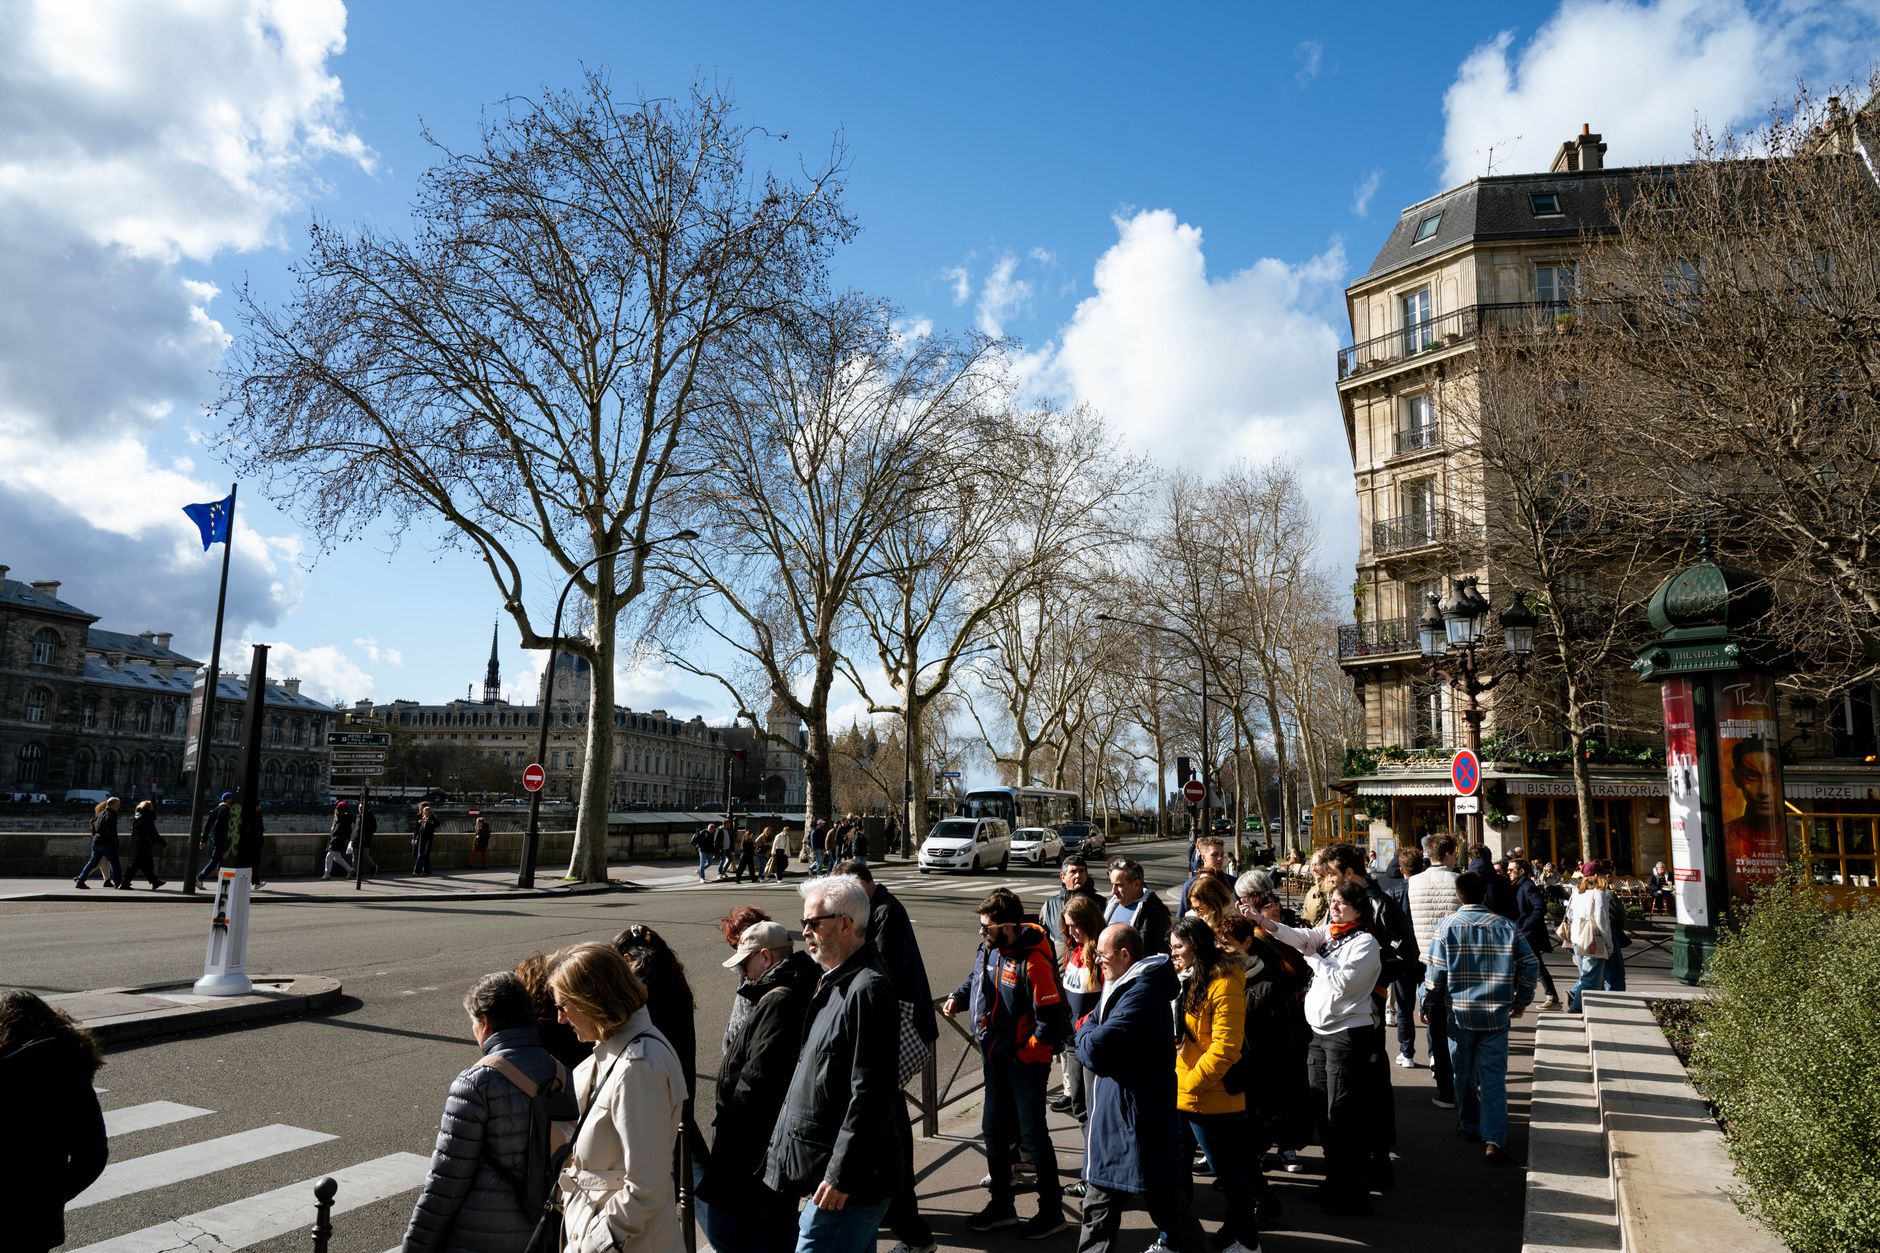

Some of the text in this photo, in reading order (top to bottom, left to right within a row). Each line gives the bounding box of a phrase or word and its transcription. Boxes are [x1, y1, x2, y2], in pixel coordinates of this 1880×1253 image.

[1720, 727, 1752, 738] CIRQUE
[1590, 785, 1660, 794] TRATTORIA
[1815, 787, 1851, 796] PIZZE
